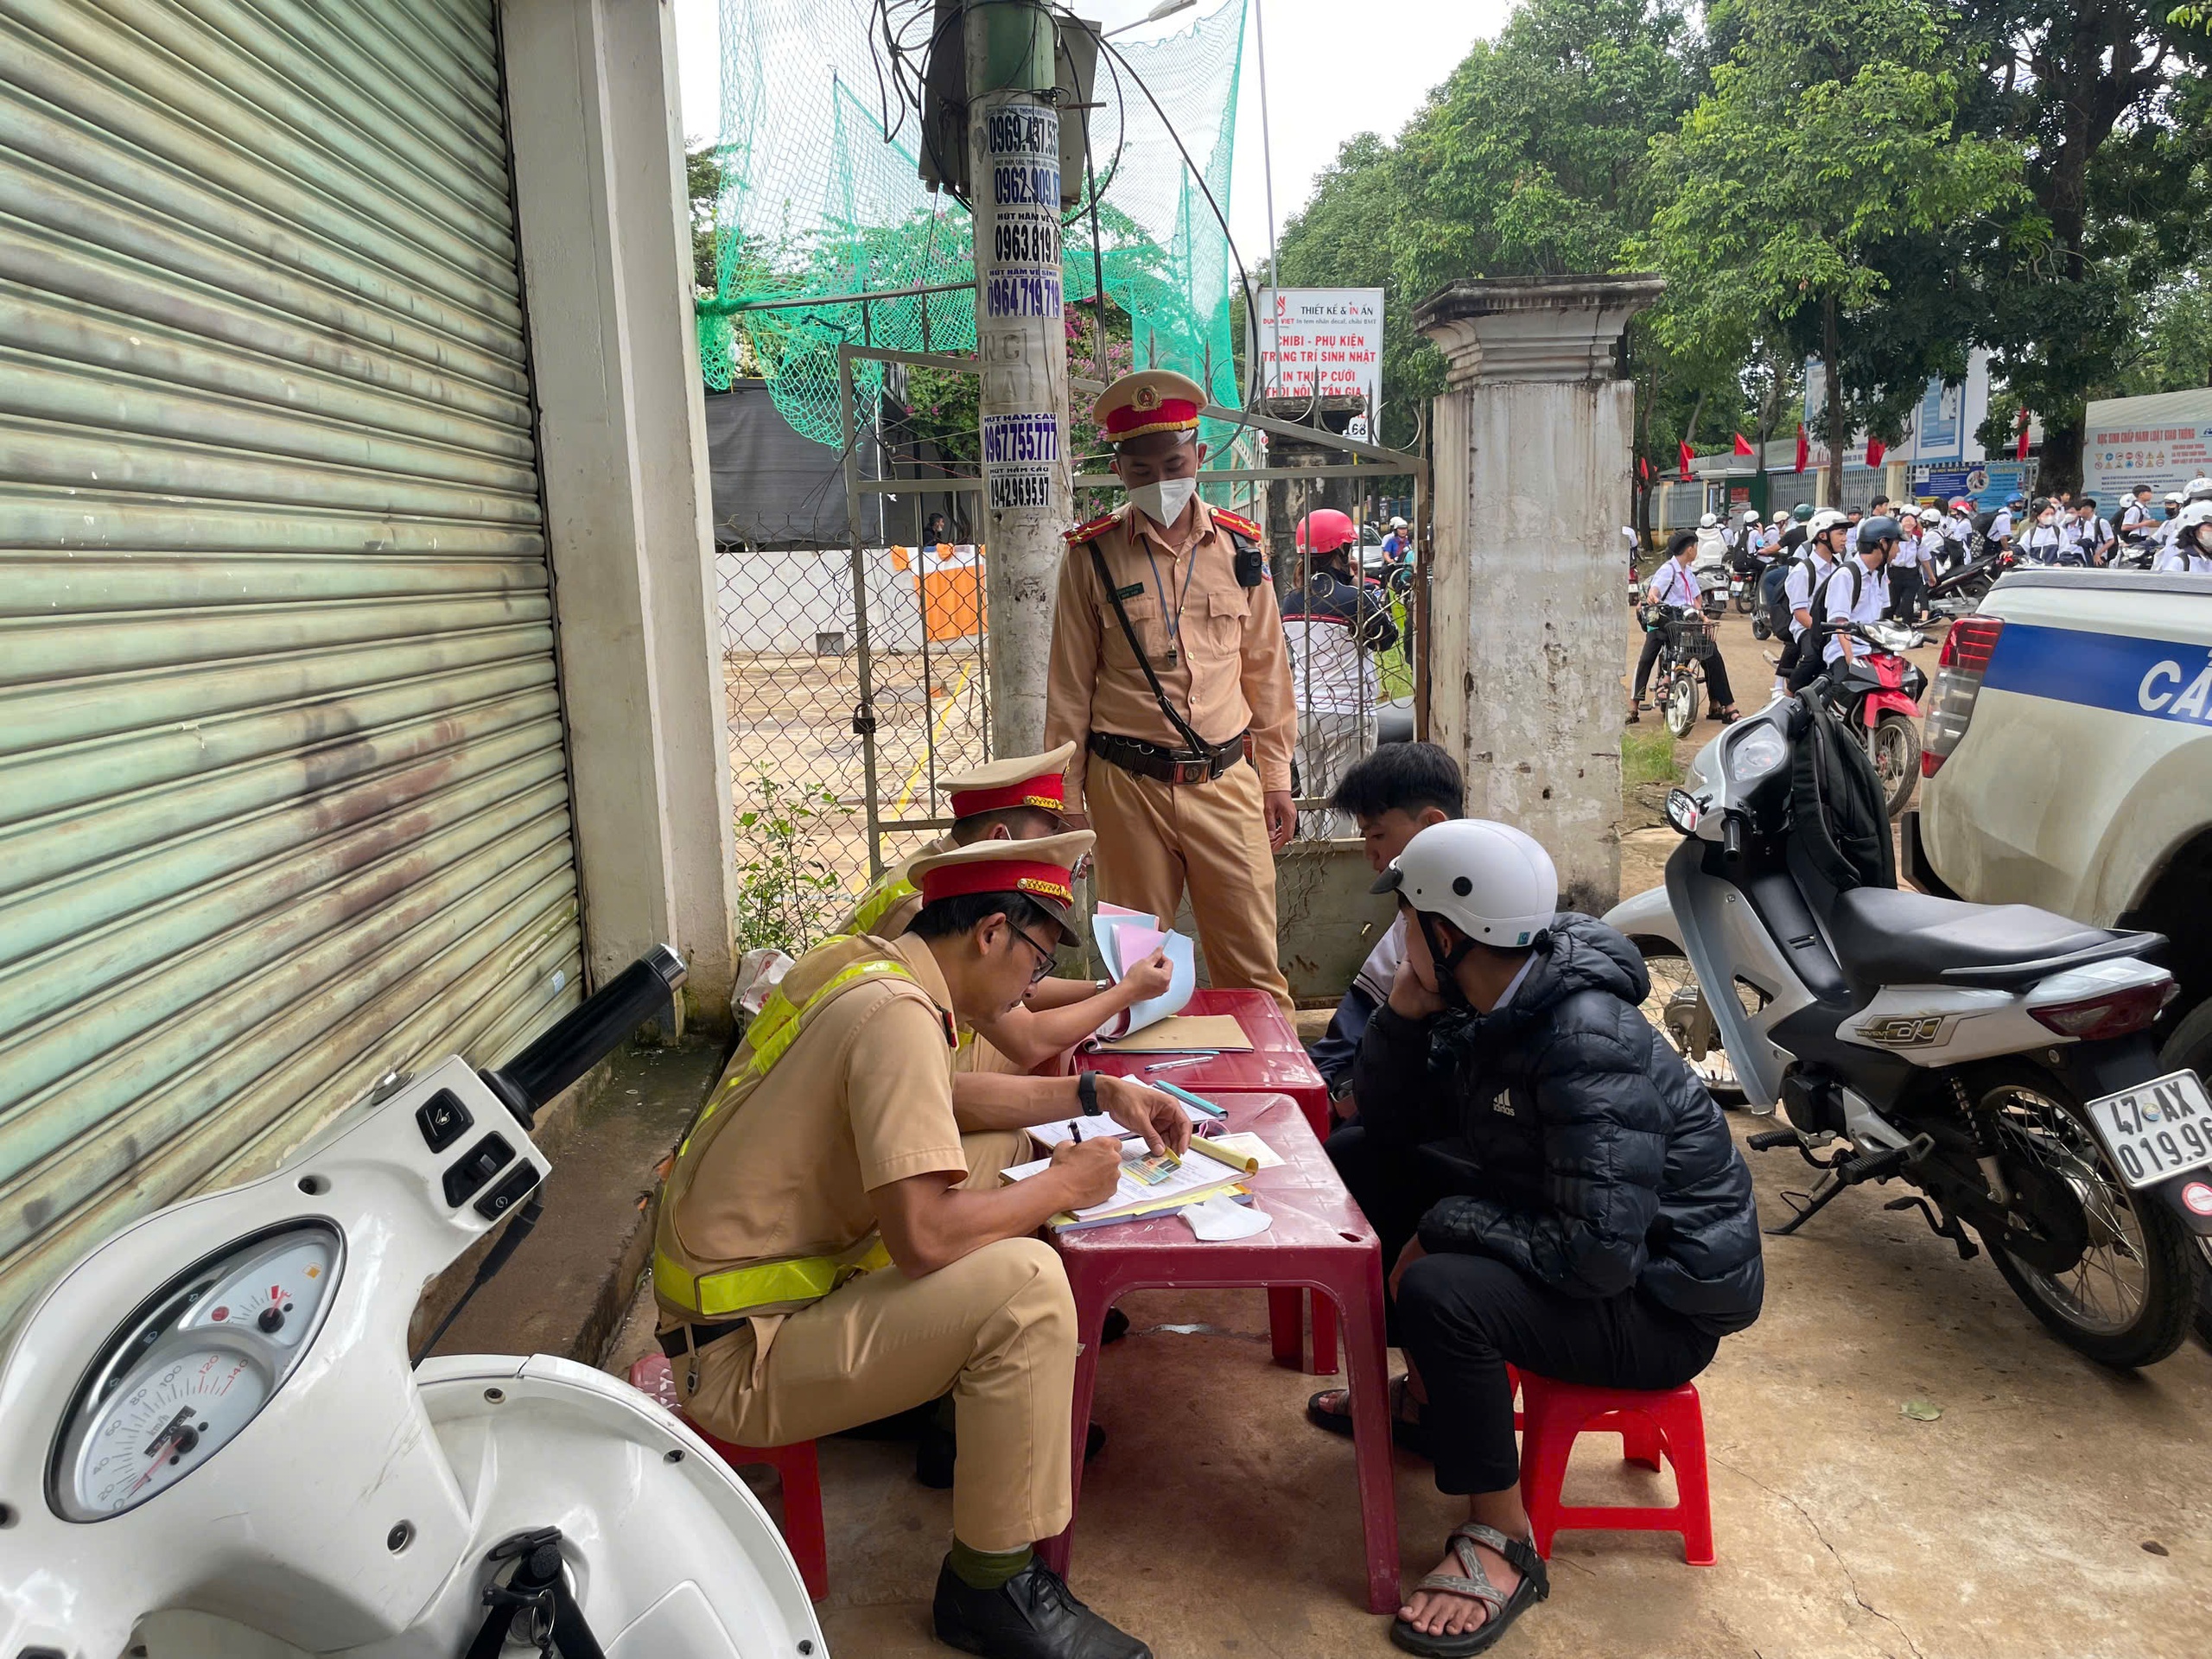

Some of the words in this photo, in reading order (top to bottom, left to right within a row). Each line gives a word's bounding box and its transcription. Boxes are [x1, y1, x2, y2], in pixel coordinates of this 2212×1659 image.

[1316, 336, 1336, 348] PHỤ
[1340, 334, 1364, 349] KIỆN
[1300, 348, 1318, 362] TRÍ
[1321, 352, 1344, 362] SINH
[1350, 349, 1376, 364] NHẬT
[1283, 372, 1293, 381] IN
[1297, 372, 1327, 381] THIP
[1332, 369, 1355, 382] CƯỚI
[985, 422, 1056, 463] 0967.755.777
[2110, 1096, 2143, 1135] 47
[2153, 1081, 2196, 1122] AX
[198, 1355, 219, 1376] 120
[227, 1357, 249, 1381] 140
[159, 1365, 182, 1388] 100
[130, 1389, 148, 1406] 80
[105, 1420, 123, 1437] 60
[93, 1457, 111, 1476] 40
[98, 1484, 115, 1501] 20
